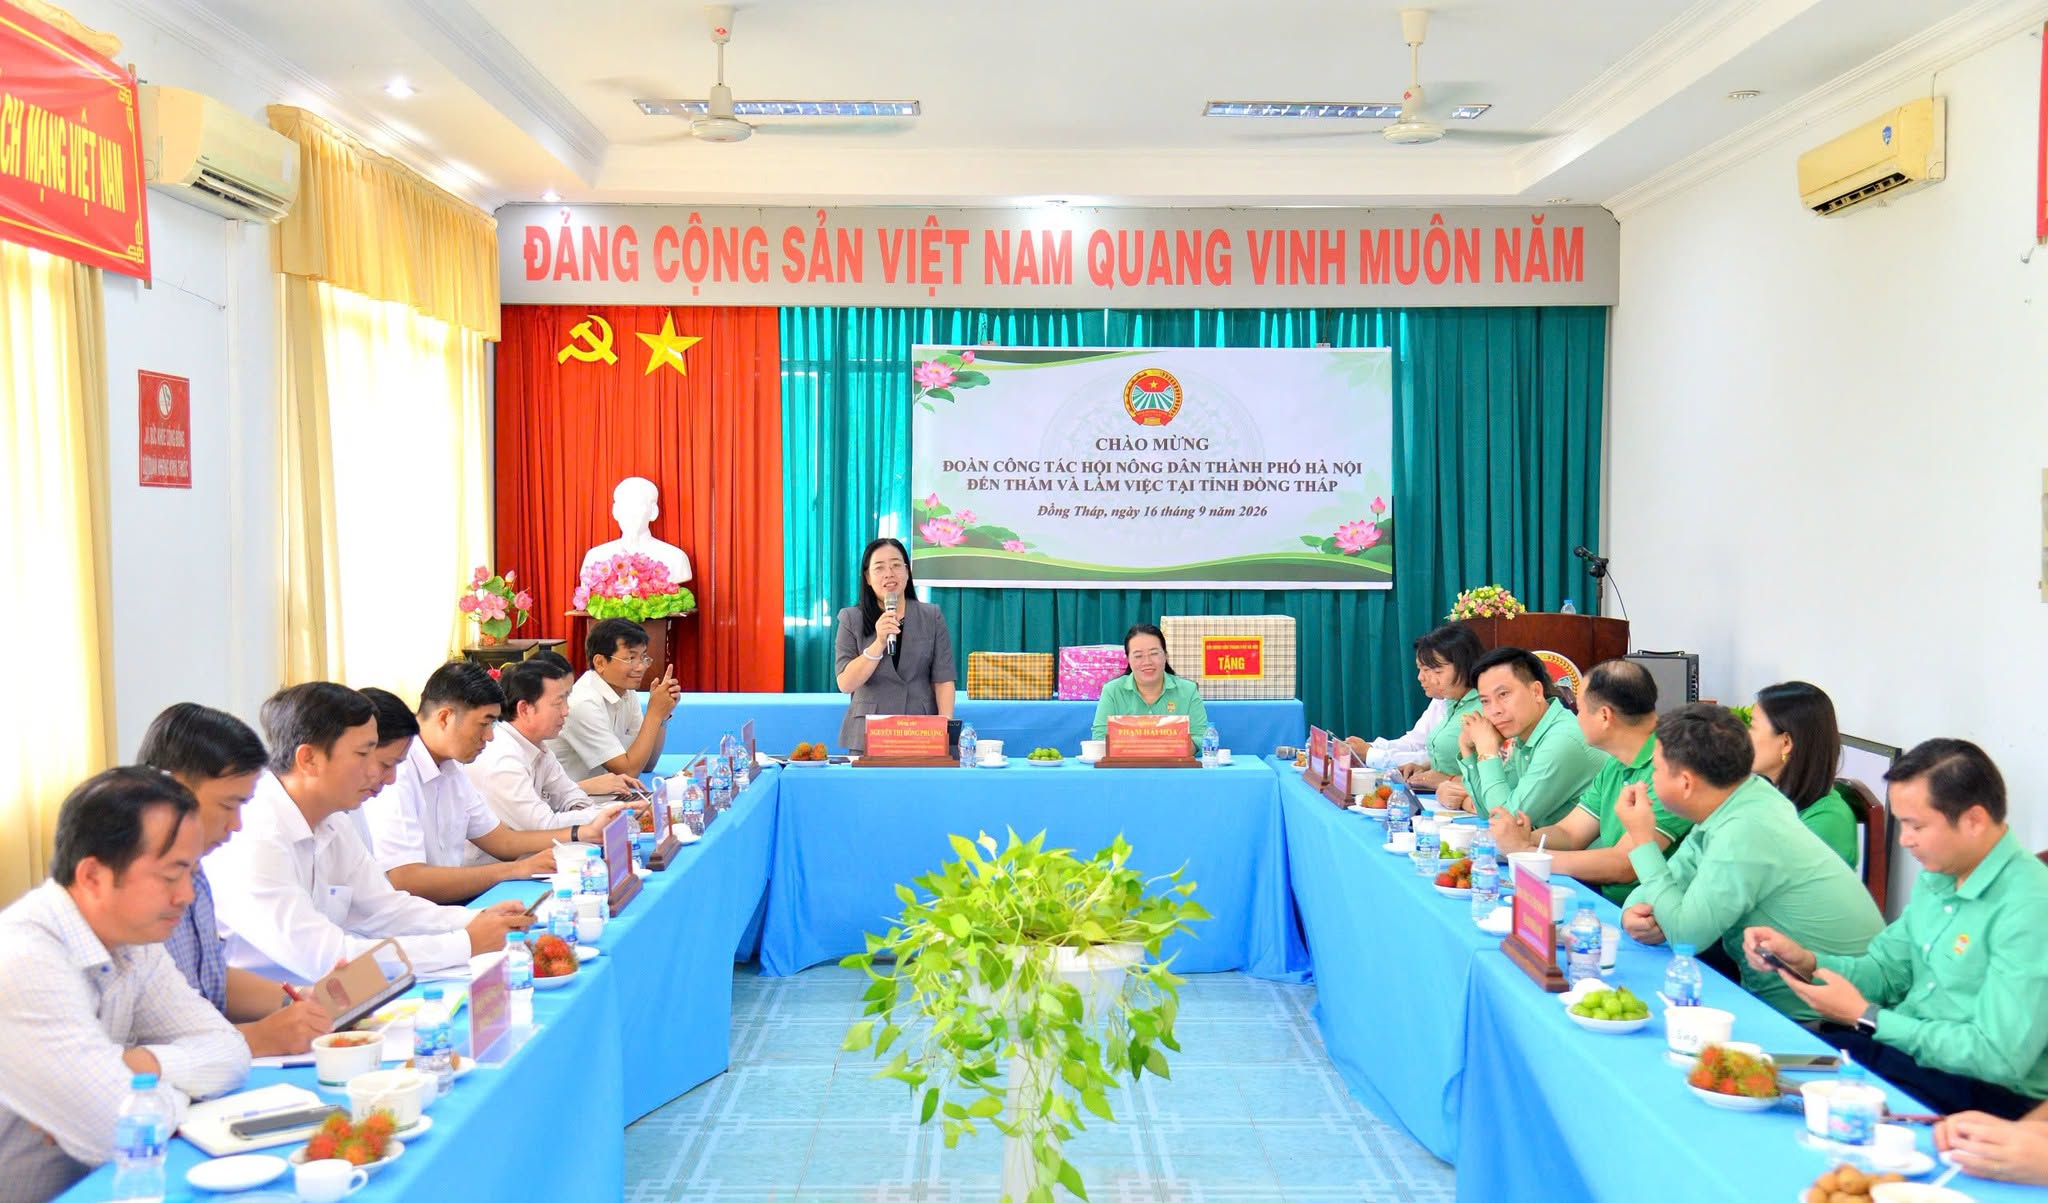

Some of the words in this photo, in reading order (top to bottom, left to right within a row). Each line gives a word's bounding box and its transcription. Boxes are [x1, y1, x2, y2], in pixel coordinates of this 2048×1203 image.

[0, 92, 24, 177] CH
[25, 103, 67, 203] MẠNG
[69, 106, 97, 217] VIỆT
[99, 135, 126, 213] NAM
[523, 208, 640, 284] ĐẢNG
[653, 211, 770, 297] CỘNG
[781, 208, 865, 284] SẢN
[877, 214, 970, 297] VIỆT
[984, 229, 1073, 286] NAM
[1087, 228, 1233, 290] QUANG
[1246, 229, 1347, 286] VINH
[1359, 213, 1482, 287] MUÔN
[1494, 213, 1585, 284] NĂM
[1095, 434, 1148, 451] CHÀO
[1153, 434, 1210, 451] MỪNG
[943, 457, 989, 473] ĐOÀN
[993, 457, 1040, 473] CÔNG
[1044, 458, 1077, 473] TÁC
[1082, 458, 1111, 477] HỘI
[1116, 458, 1163, 474] NÔNG
[1167, 458, 1201, 474] DÂN
[1205, 458, 1263, 474] THÀNH
[1267, 459, 1301, 474] PHỐ
[1305, 459, 1328, 474] HÀ
[1333, 459, 1362, 477] NỘI
[967, 476, 1000, 490] ĐẾN
[1004, 476, 1052, 491] THĂM
[1057, 476, 1080, 491] VÀ
[1084, 476, 1120, 491] LÀM
[1124, 477, 1164, 494] VIỆC
[1167, 479, 1194, 494] TẠI
[1199, 476, 1238, 491] TỈNH
[1243, 477, 1290, 492] ĐỒNG
[1294, 477, 1338, 492] THÁP
[1037, 503, 1070, 518] Đồng
[1074, 505, 1107, 519] Tháp,
[1111, 506, 1140, 519] ngày
[1144, 506, 1158, 517] 16
[1161, 505, 1195, 519] tháng
[1199, 506, 1206, 517] 9
[1209, 506, 1235, 517] năm
[1239, 506, 1268, 517] 2026
[1218, 654, 1245, 672] TẶNG
